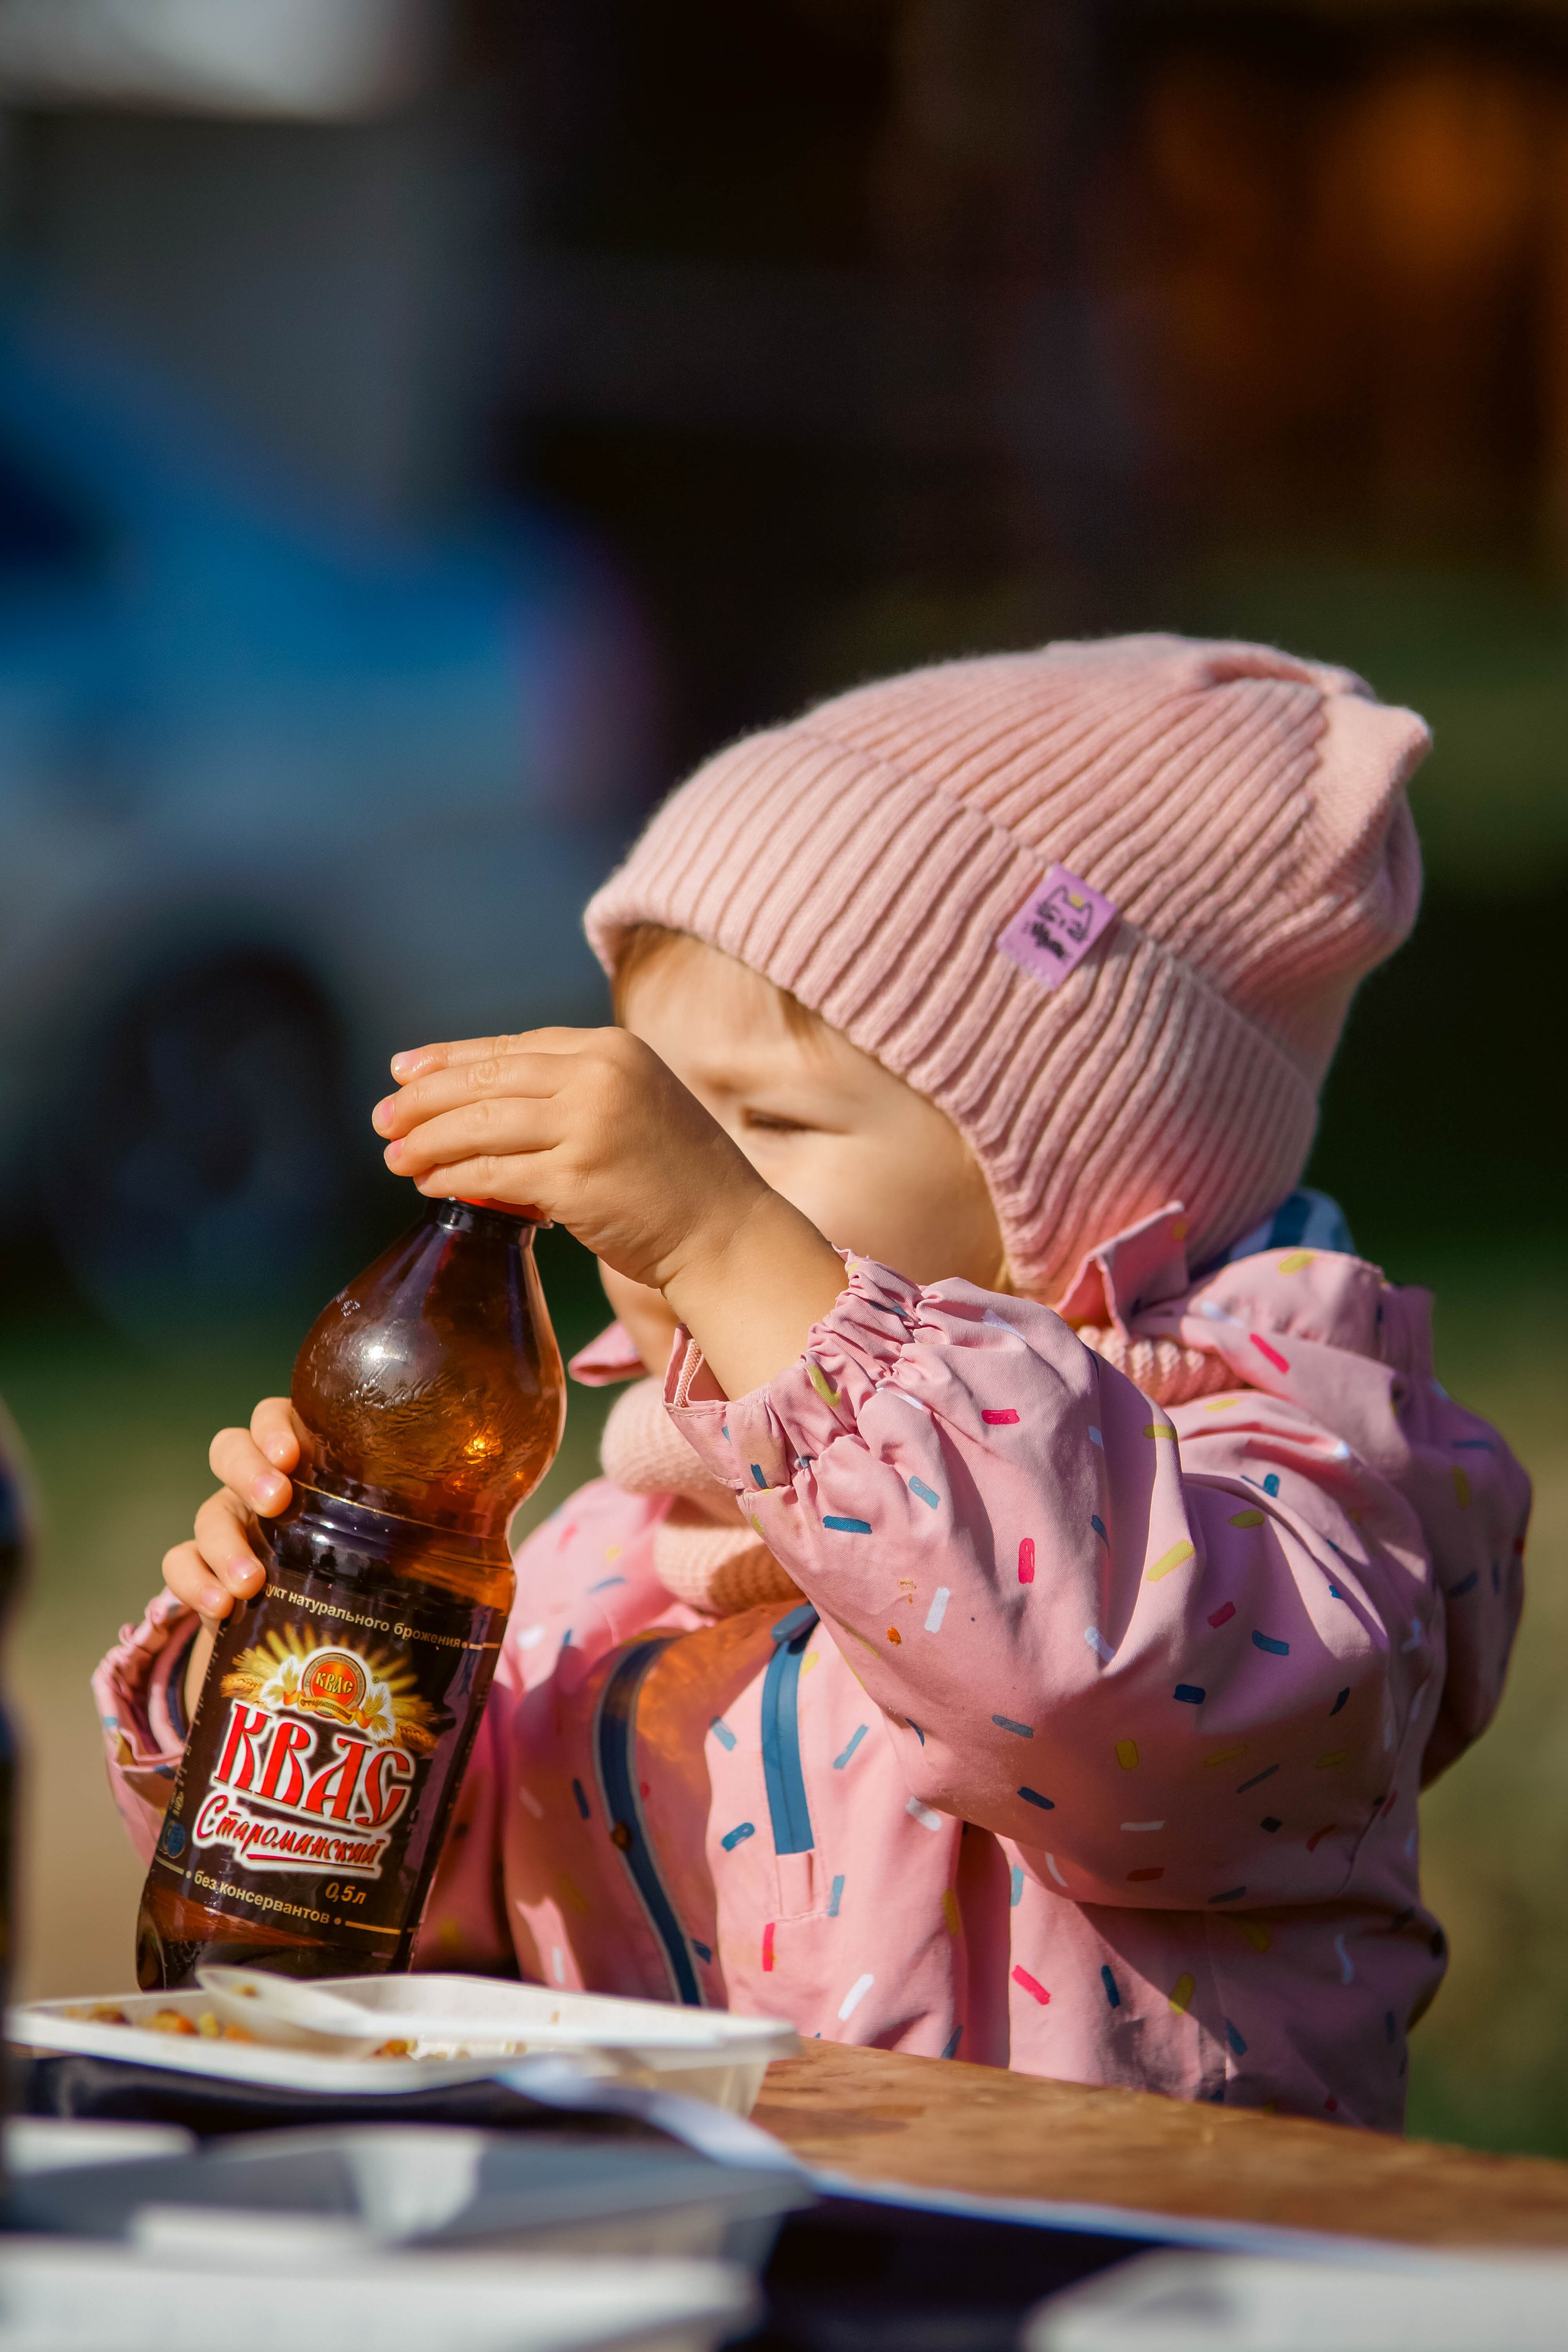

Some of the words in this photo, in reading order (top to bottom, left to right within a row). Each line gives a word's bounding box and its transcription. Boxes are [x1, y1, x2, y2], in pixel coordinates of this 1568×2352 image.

[288, 1591, 390, 1632] натурального
[394, 1623, 461, 1648] брожения
[315, 1672, 354, 1695] КВАС
[214, 1703, 410, 1828] КВАС
[194, 1870, 216, 1890] без
[219, 1881, 331, 1924] консервантов
